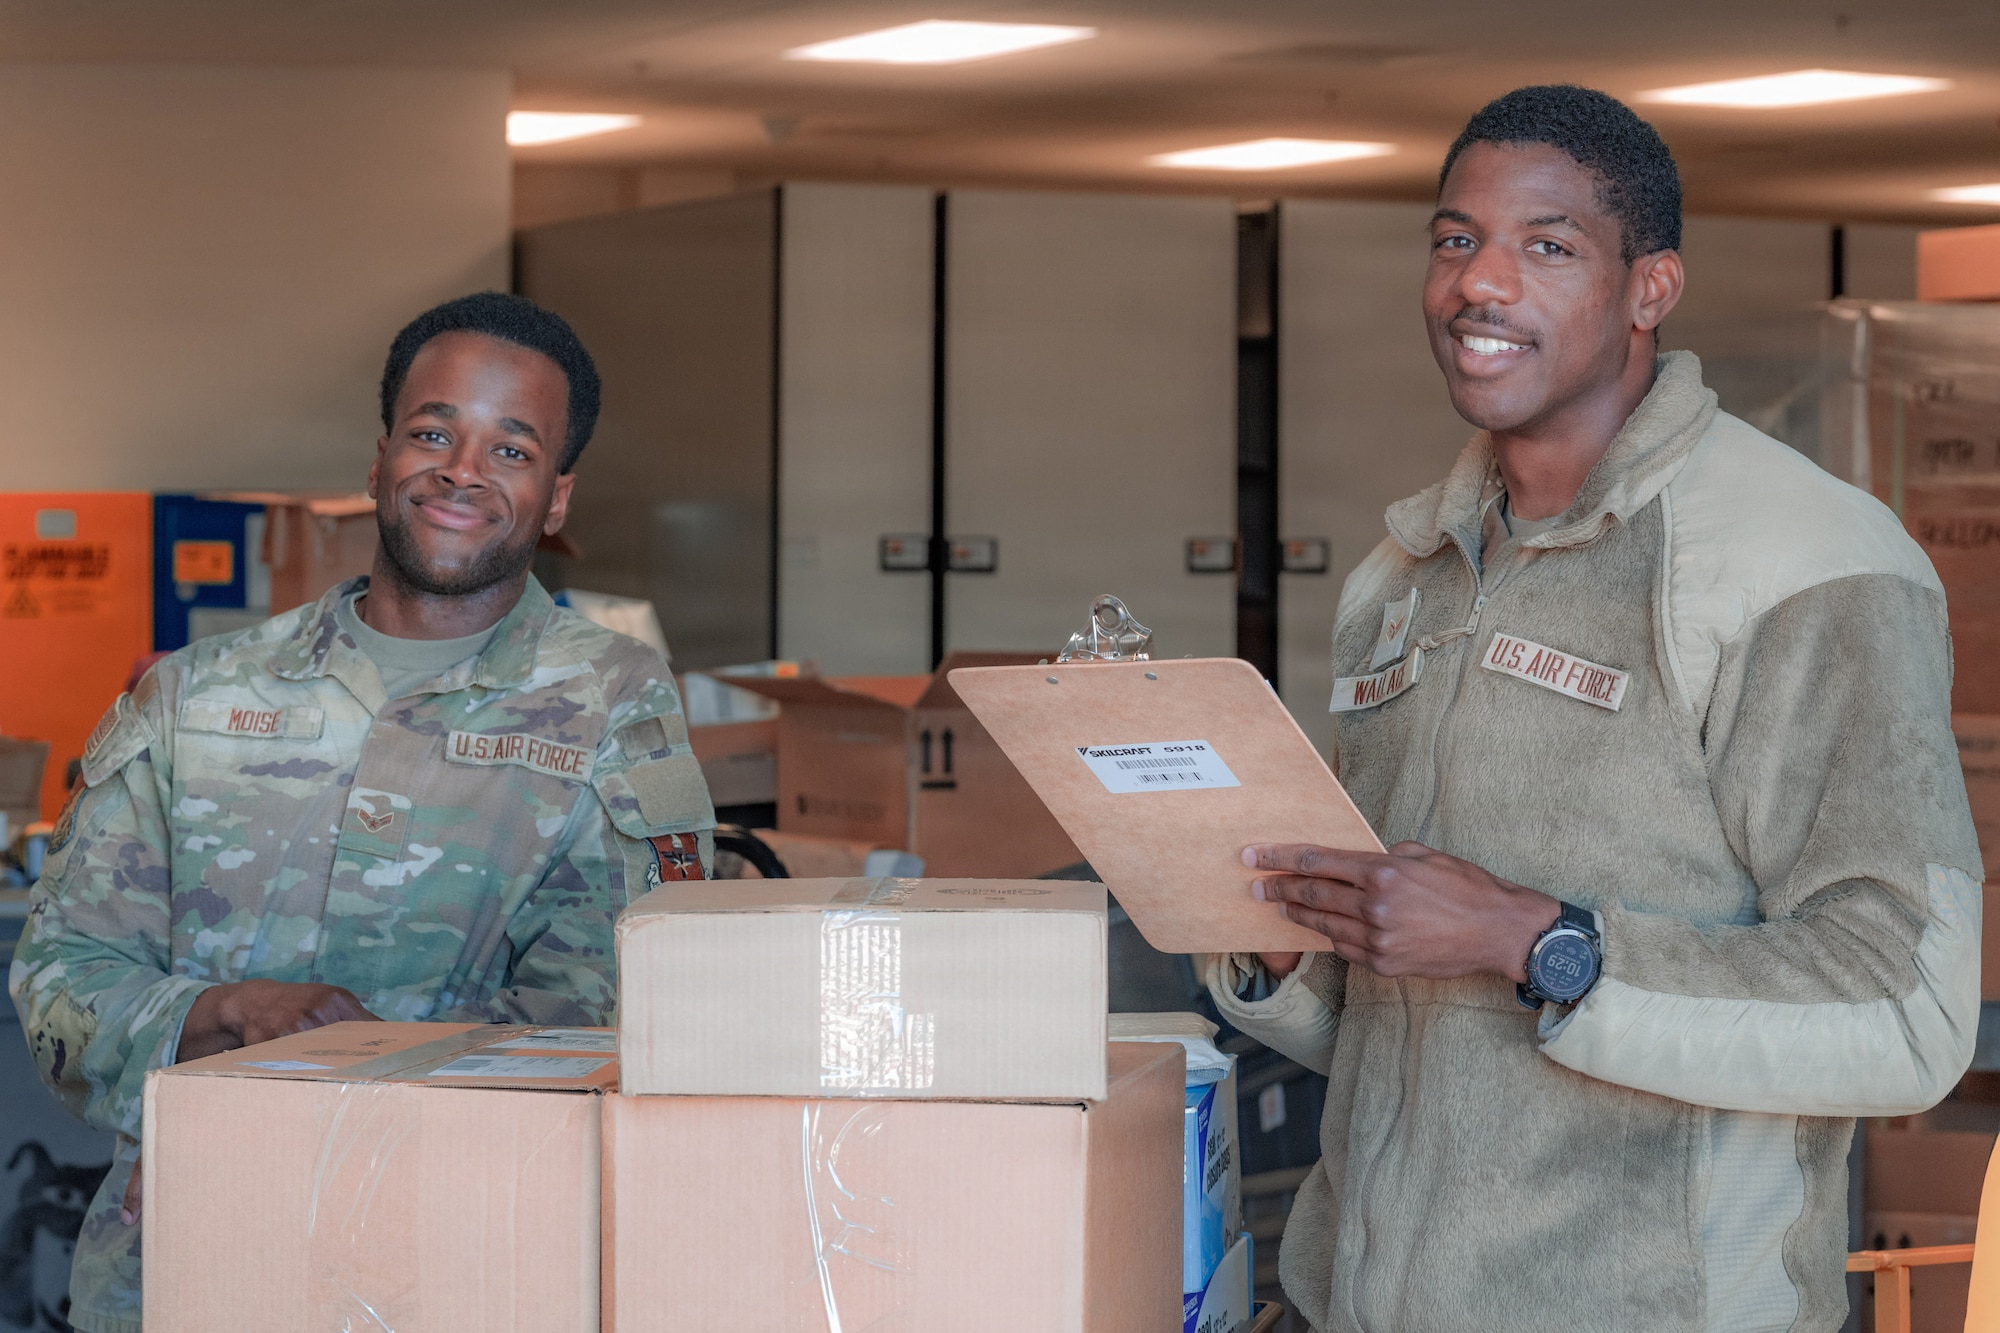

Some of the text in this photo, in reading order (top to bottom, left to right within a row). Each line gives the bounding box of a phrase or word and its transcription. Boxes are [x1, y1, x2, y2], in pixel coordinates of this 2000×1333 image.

[1490, 637, 1621, 703] U.S. AIR FORCE
[227, 707, 282, 734] MOISE
[493, 734, 524, 760] AIR
[527, 738, 588, 776] FORCE
[1089, 744, 1206, 758] SKILCRAFT 5918
[1546, 954, 1581, 978] 10:29
